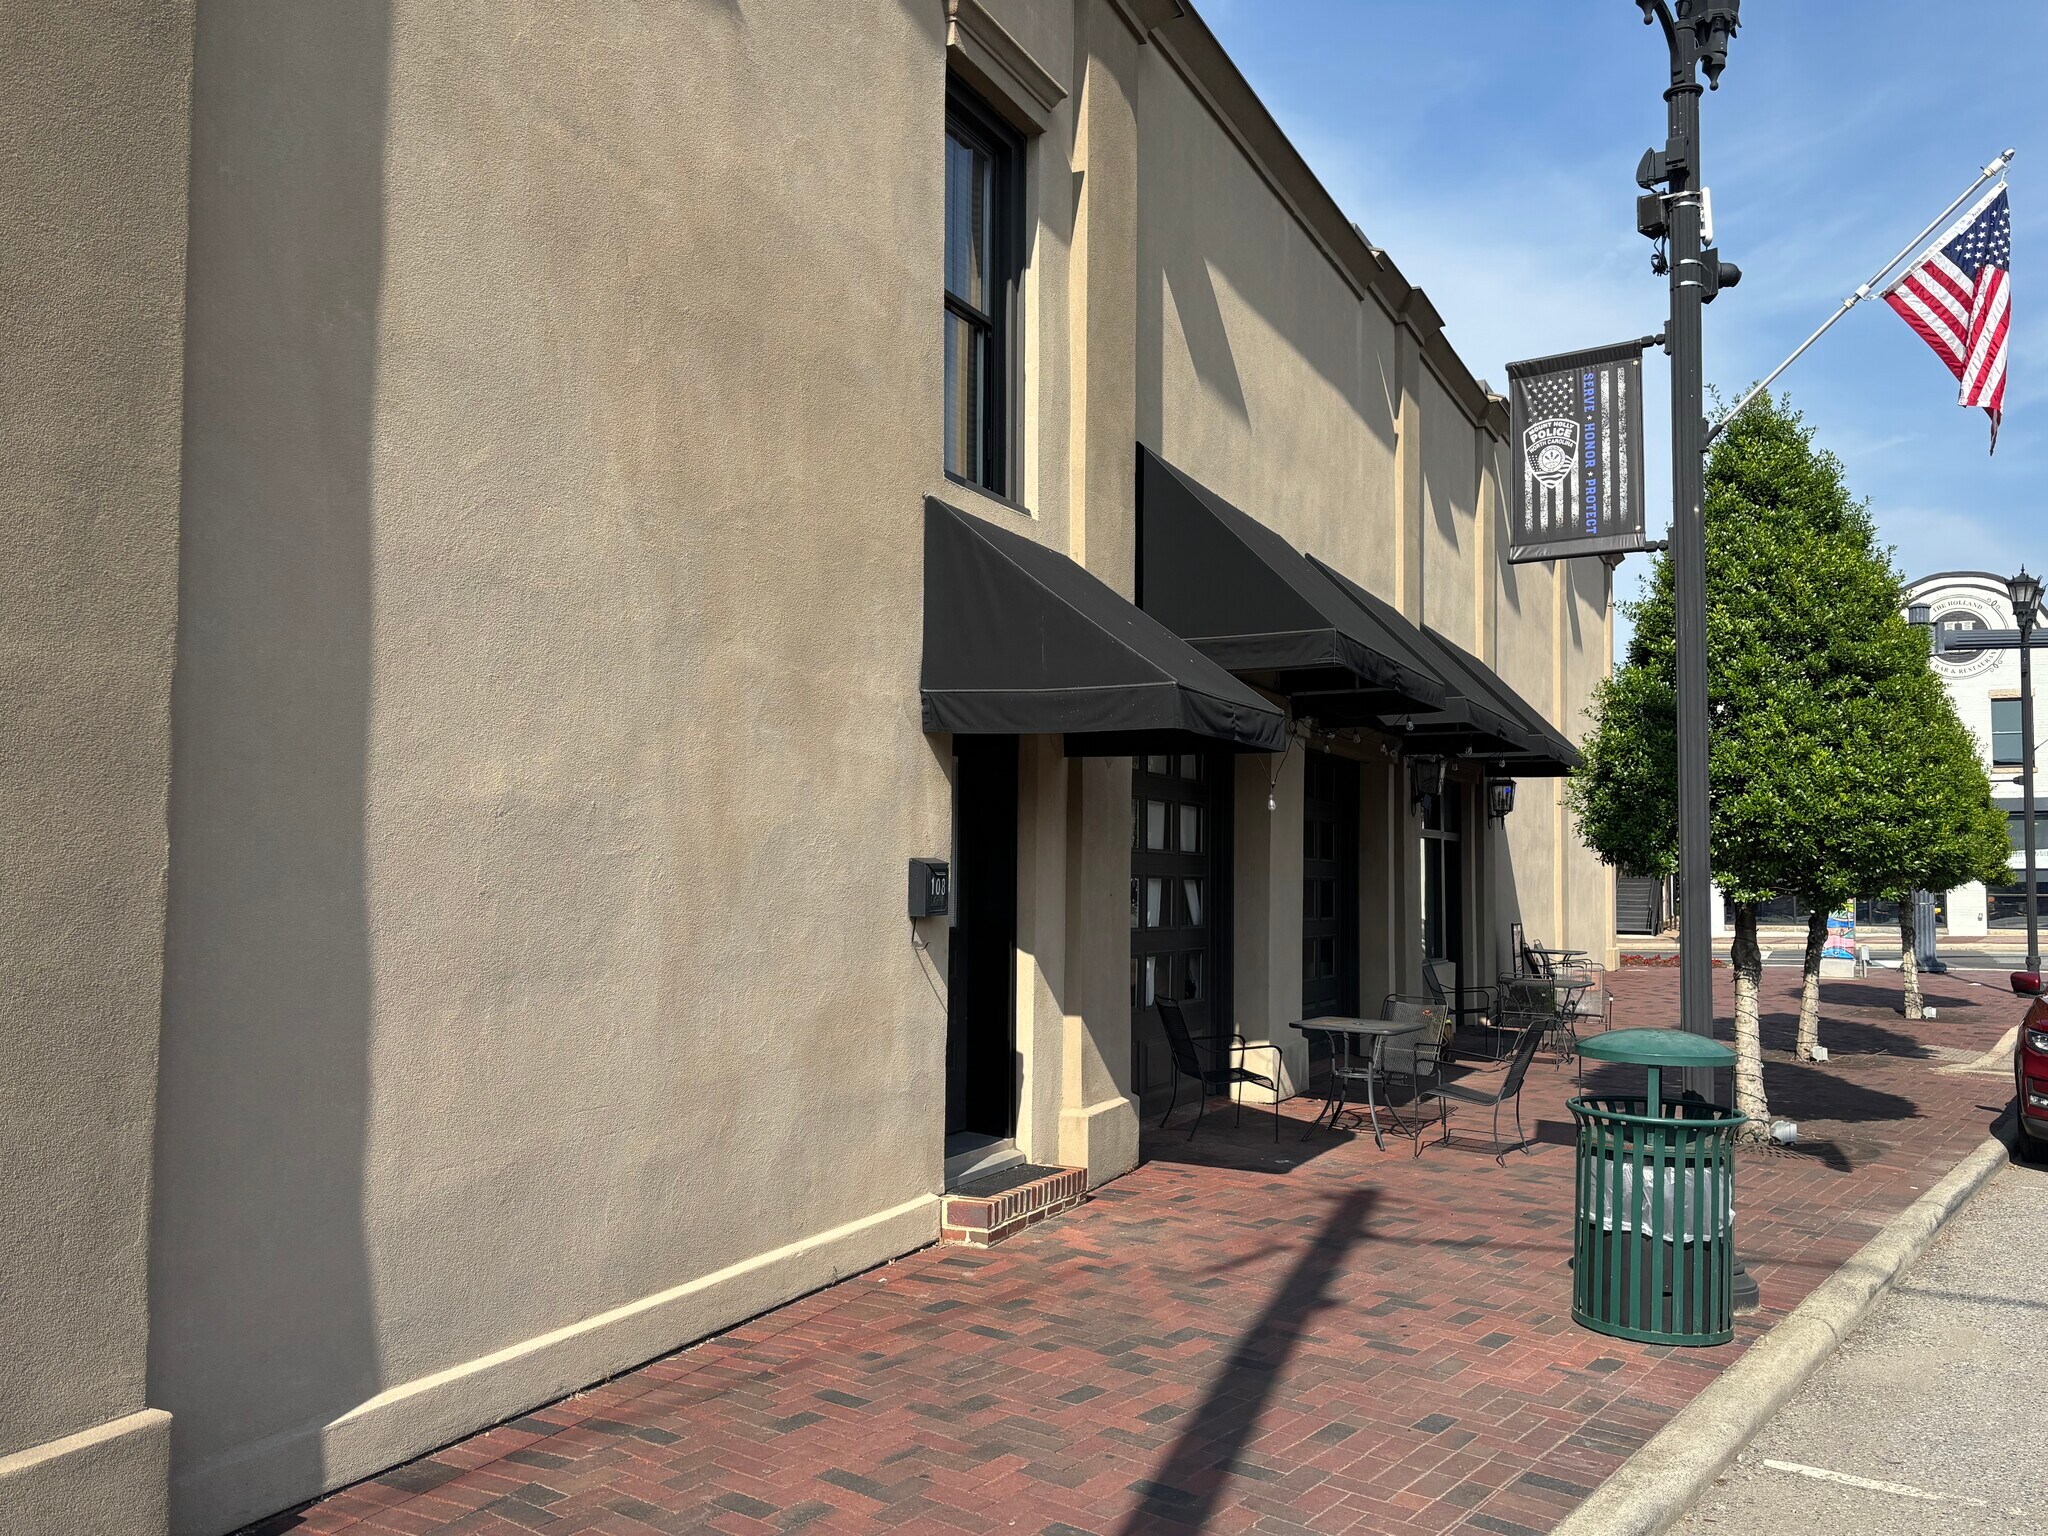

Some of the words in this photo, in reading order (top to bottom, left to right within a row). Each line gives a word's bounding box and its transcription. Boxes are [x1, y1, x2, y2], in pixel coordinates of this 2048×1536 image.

[1584, 373, 1595, 413] SERVE
[1528, 422, 1552, 435] MOUNT
[1553, 421, 1575, 429] HOLLY
[1530, 427, 1573, 443] POLICE
[1529, 441, 1547, 454] NORTH
[1547, 438, 1574, 448] CAROLINA
[1585, 423, 1596, 469] HONOR
[1586, 479, 1597, 534] PROTECT
[1933, 604, 1947, 612] THE
[1947, 600, 1983, 610] HOLLAND
[1958, 650, 1997, 674] RESTAURAN
[931, 877, 946, 896] 108
